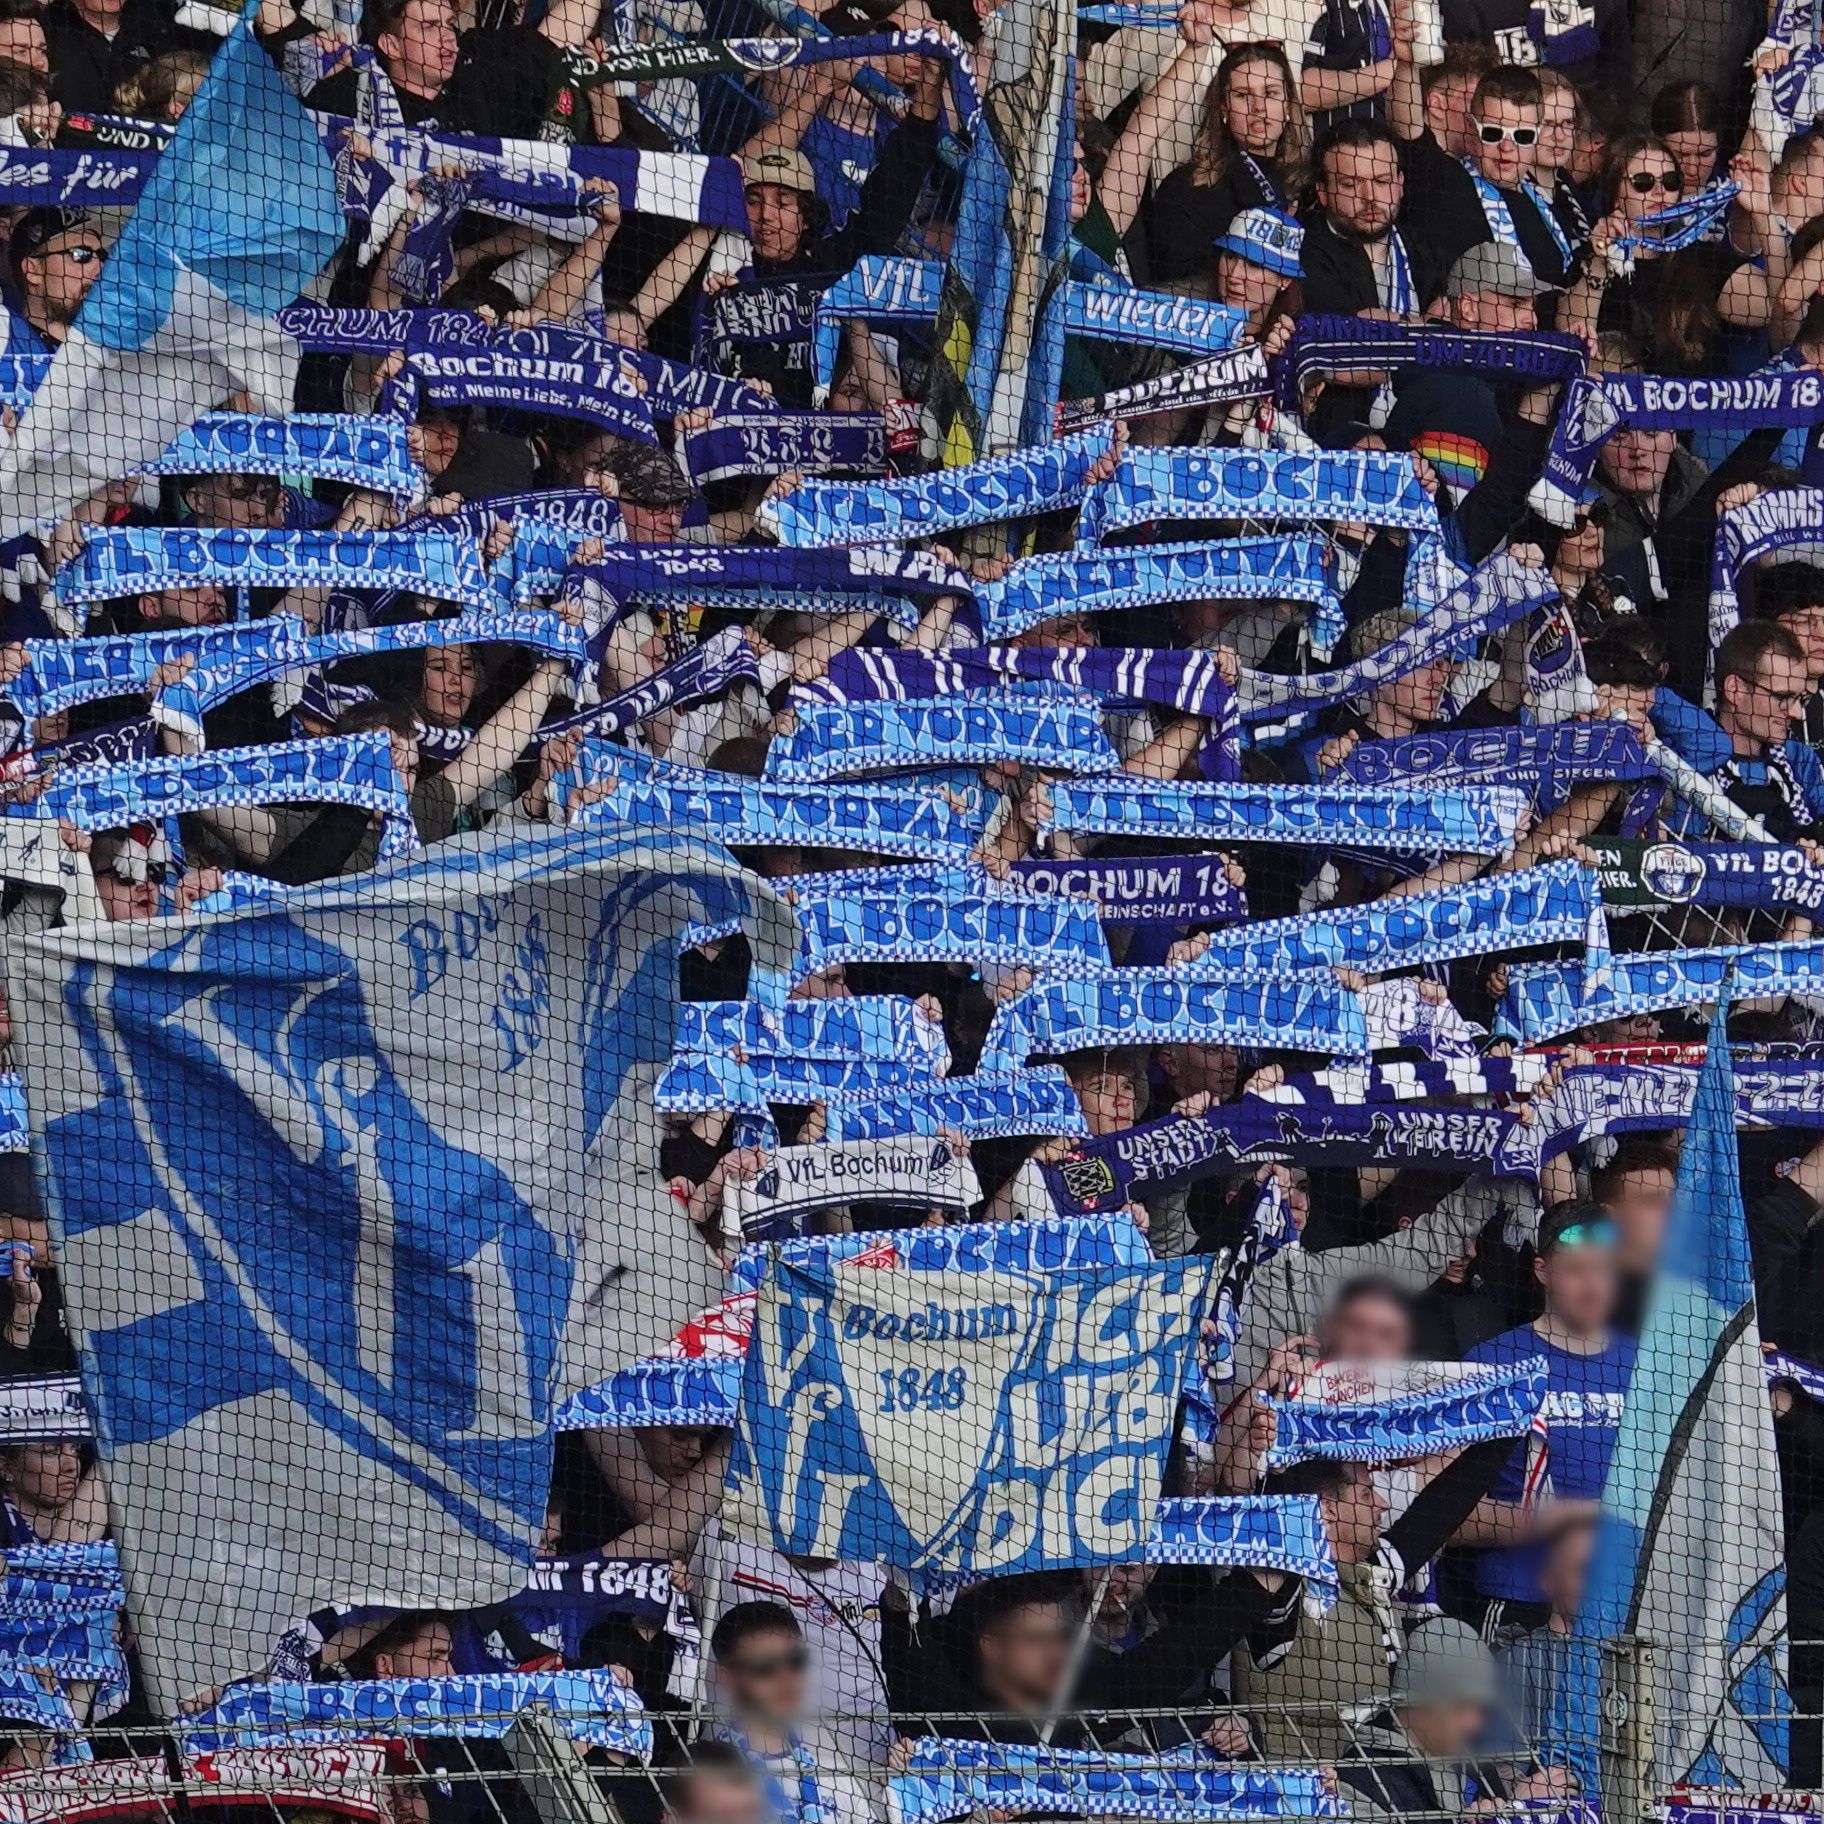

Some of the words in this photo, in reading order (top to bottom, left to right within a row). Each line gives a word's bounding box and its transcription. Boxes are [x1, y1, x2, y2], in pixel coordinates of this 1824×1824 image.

[56, 160, 140, 193] für
[860, 259, 933, 307] VfL
[1084, 297, 1228, 342] wieder
[1643, 378, 1781, 412] BOCHUM
[530, 499, 612, 537] 1848
[661, 557, 725, 577] 1848
[1359, 724, 1649, 784] BOCHUM
[1707, 851, 1756, 877] VfL
[1007, 865, 1184, 902] BOCHUM
[1772, 879, 1823, 909] 1848
[1397, 1110, 1503, 1137] UNSER
[786, 1143, 826, 1184] VfL
[830, 1150, 925, 1177] Bochum
[843, 1300, 1019, 1345] Bochum
[879, 1366, 968, 1412] 1848
[580, 1558, 676, 1599] 1848
